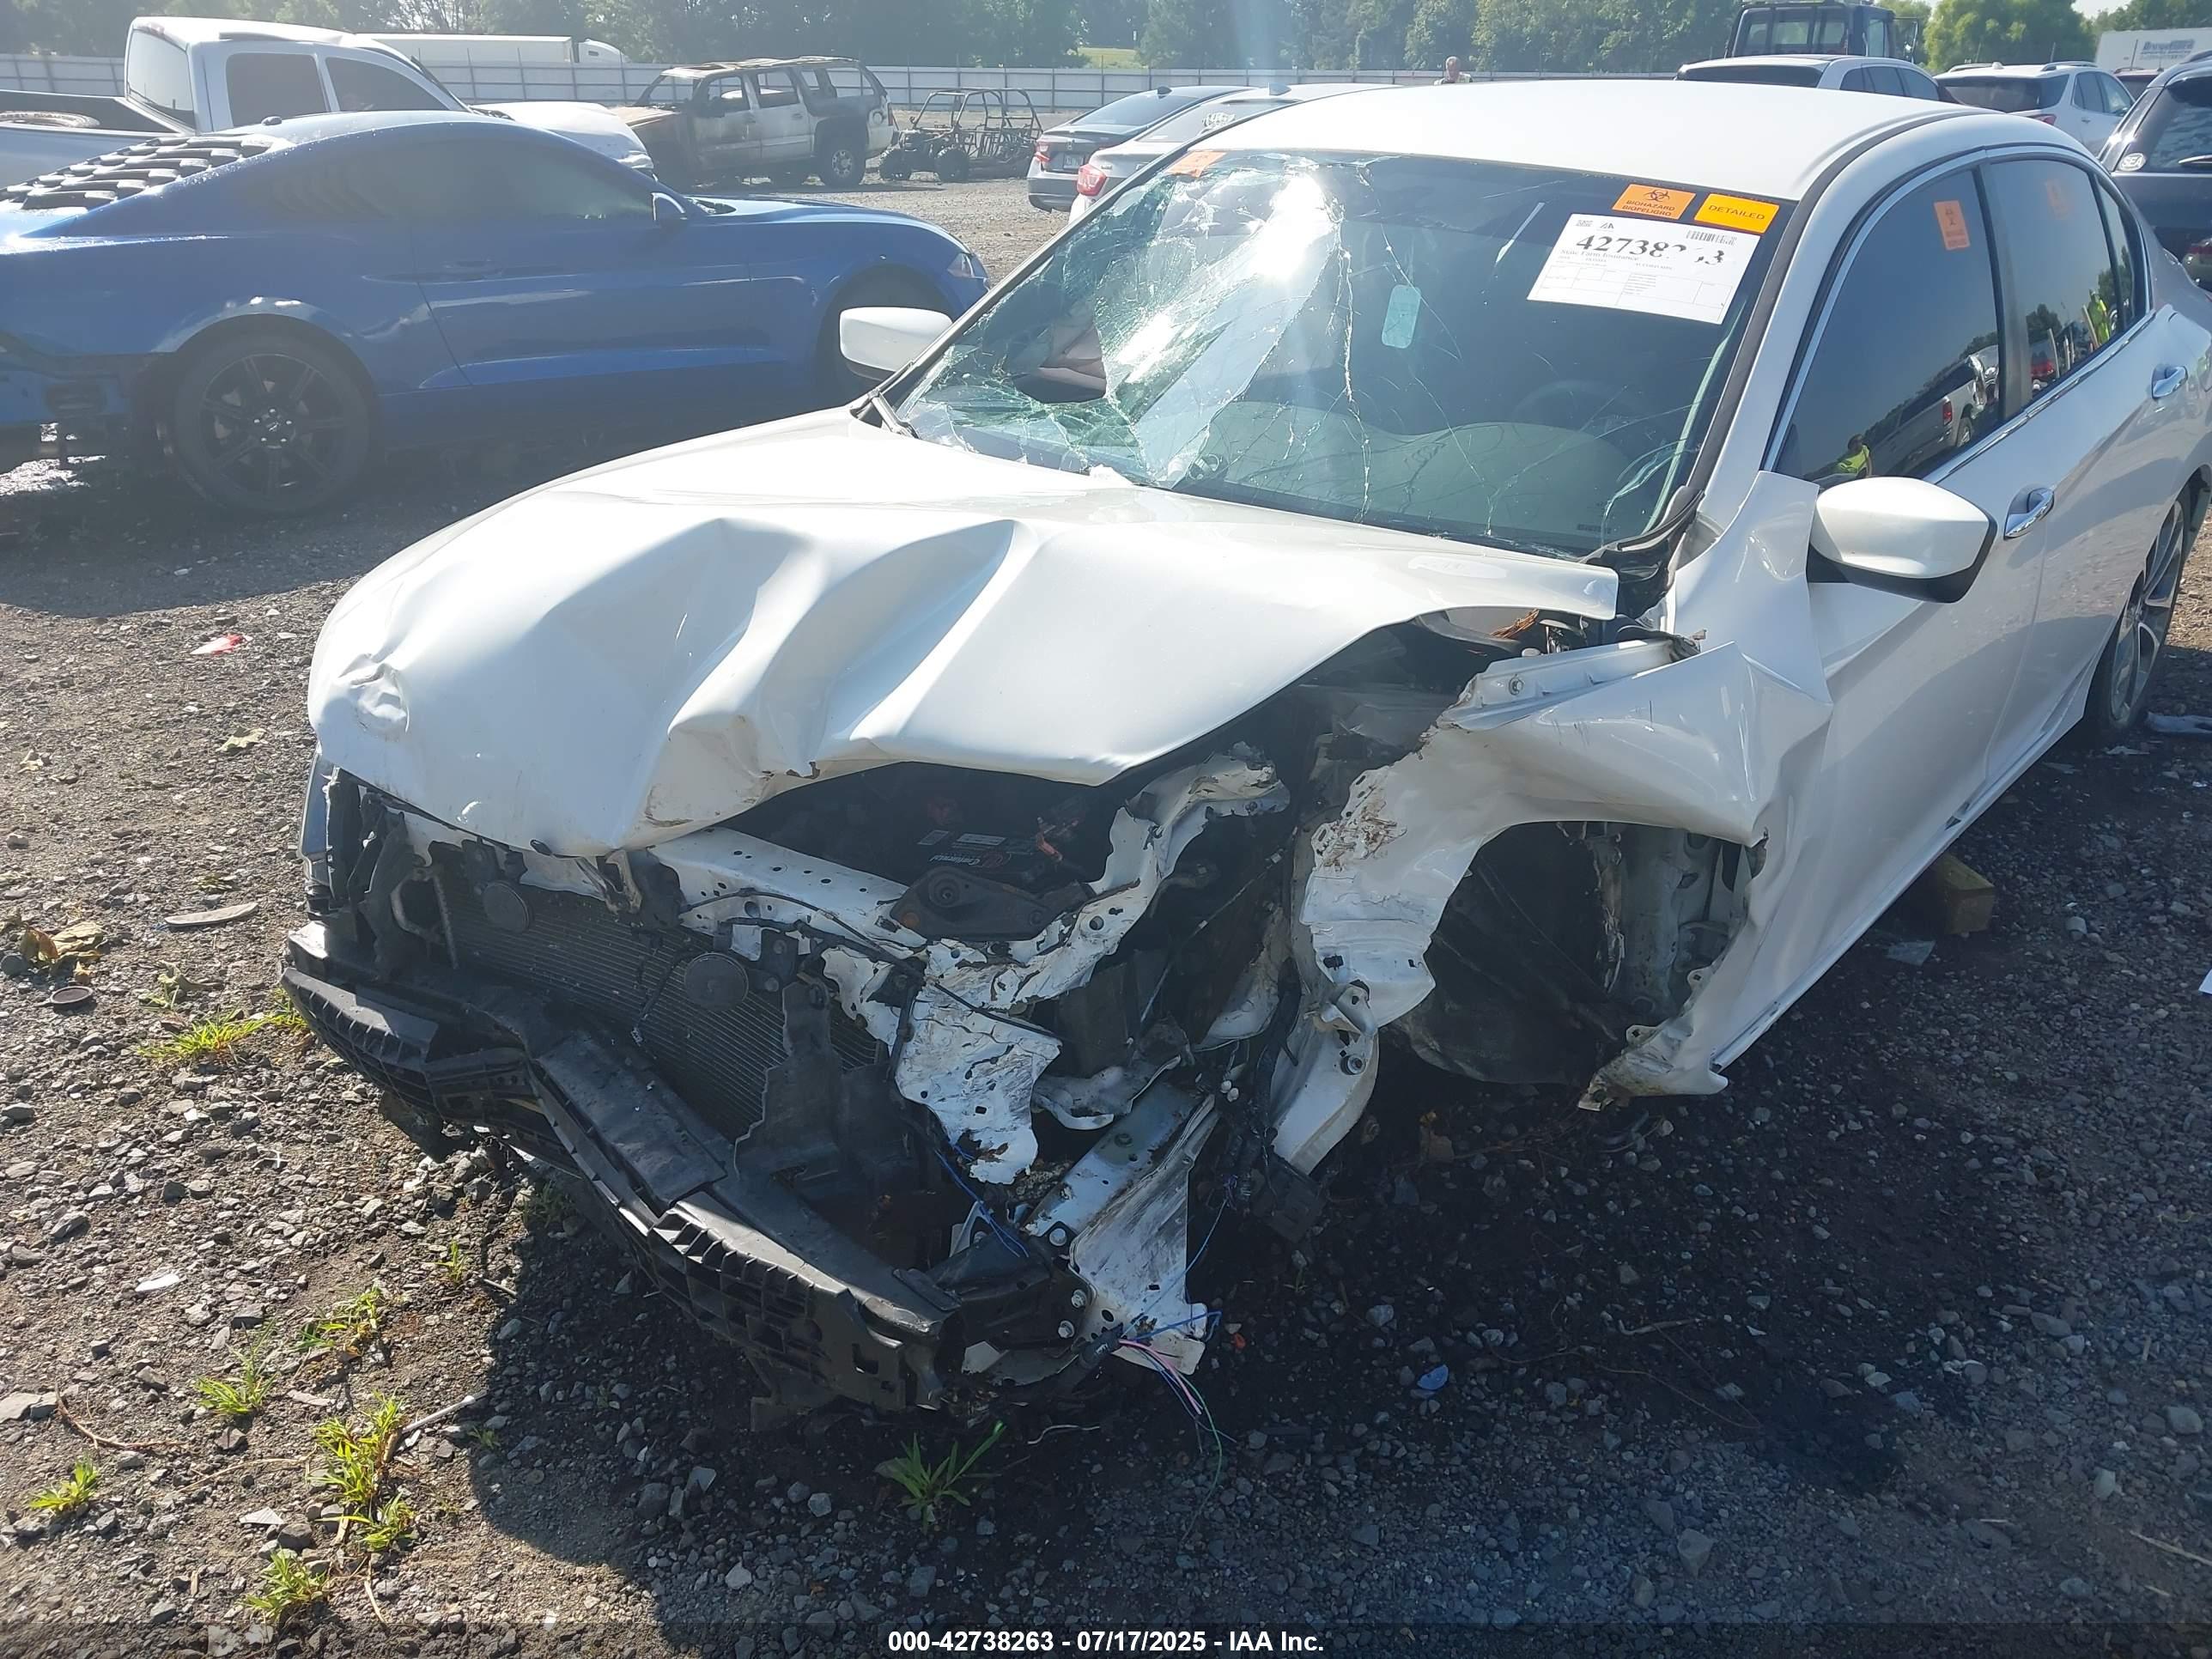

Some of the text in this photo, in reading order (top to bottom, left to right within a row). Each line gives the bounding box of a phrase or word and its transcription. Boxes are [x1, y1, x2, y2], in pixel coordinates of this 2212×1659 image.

[1622, 204, 1672, 216] BIOPELIGRO
[1626, 199, 1675, 211] BIOHAZARD
[1708, 204, 1765, 220] DETAILED
